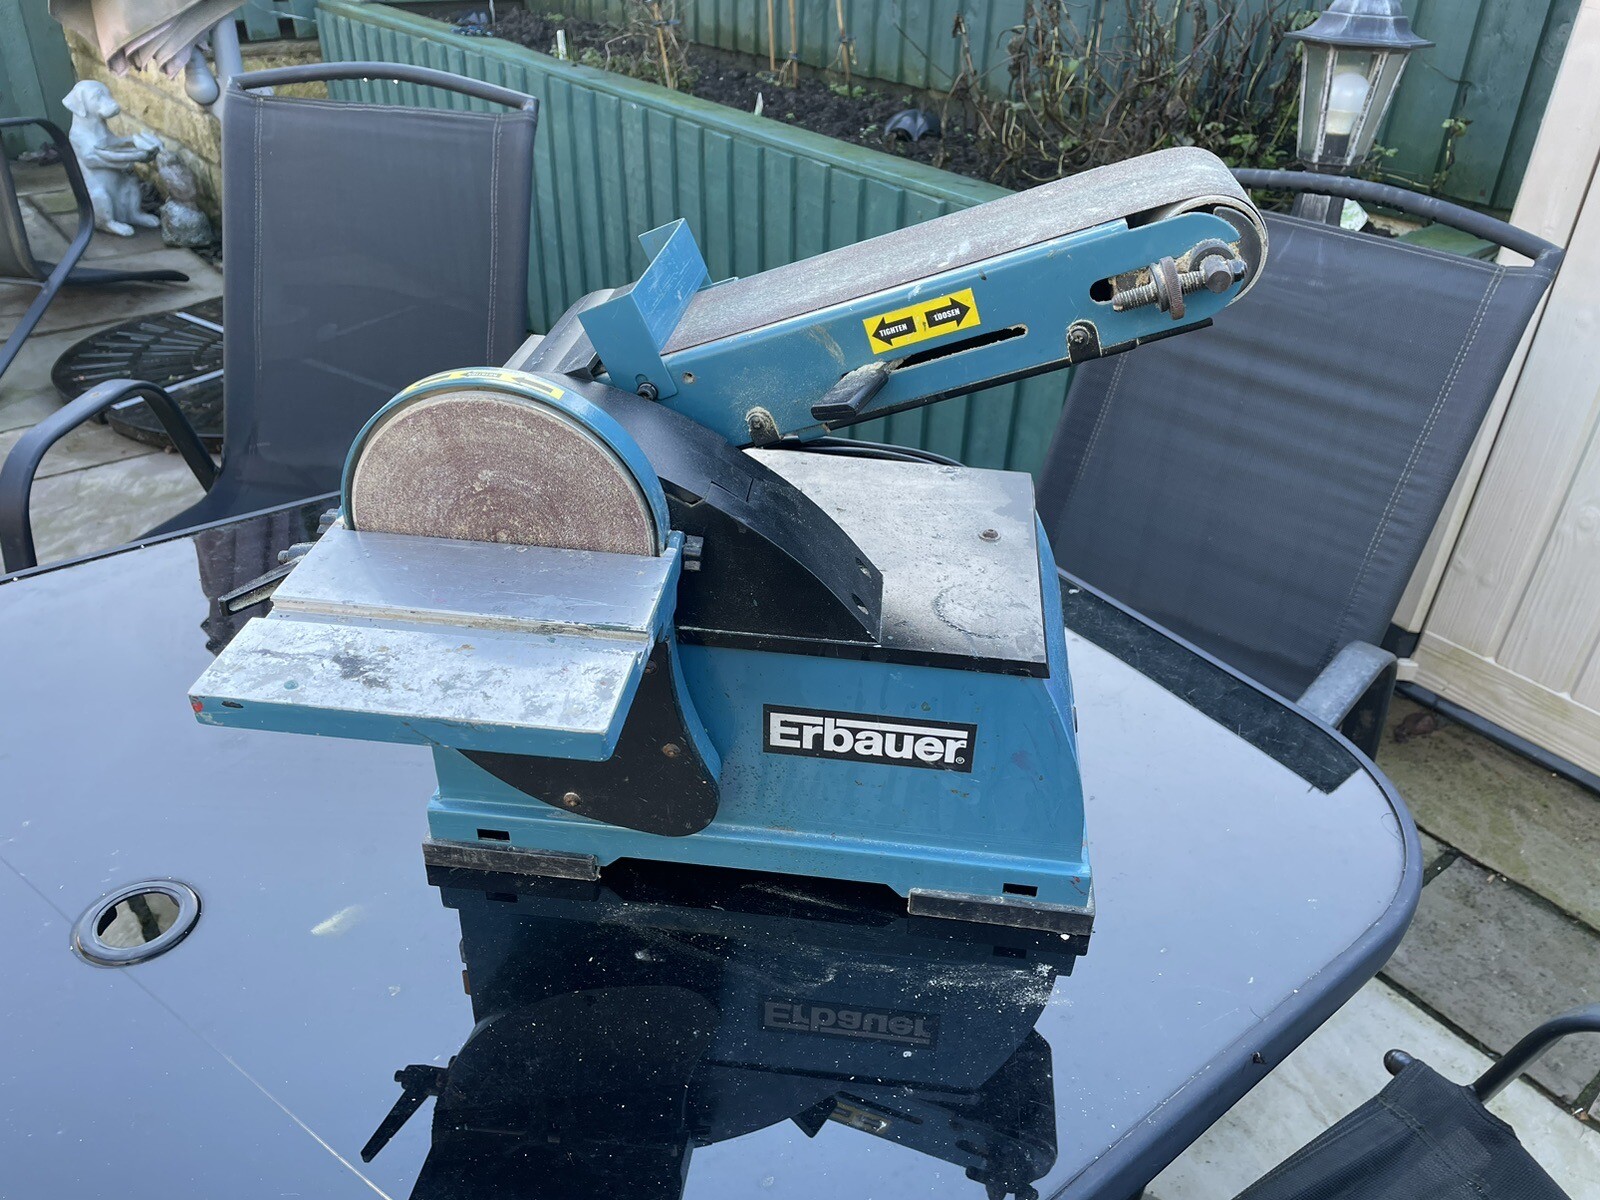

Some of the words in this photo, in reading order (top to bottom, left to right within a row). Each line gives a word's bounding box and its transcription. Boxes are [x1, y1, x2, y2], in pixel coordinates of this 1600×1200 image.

[933, 308, 961, 322] LOOSEN
[879, 323, 908, 337] TIGHTEN
[769, 712, 969, 765] Erbauer
